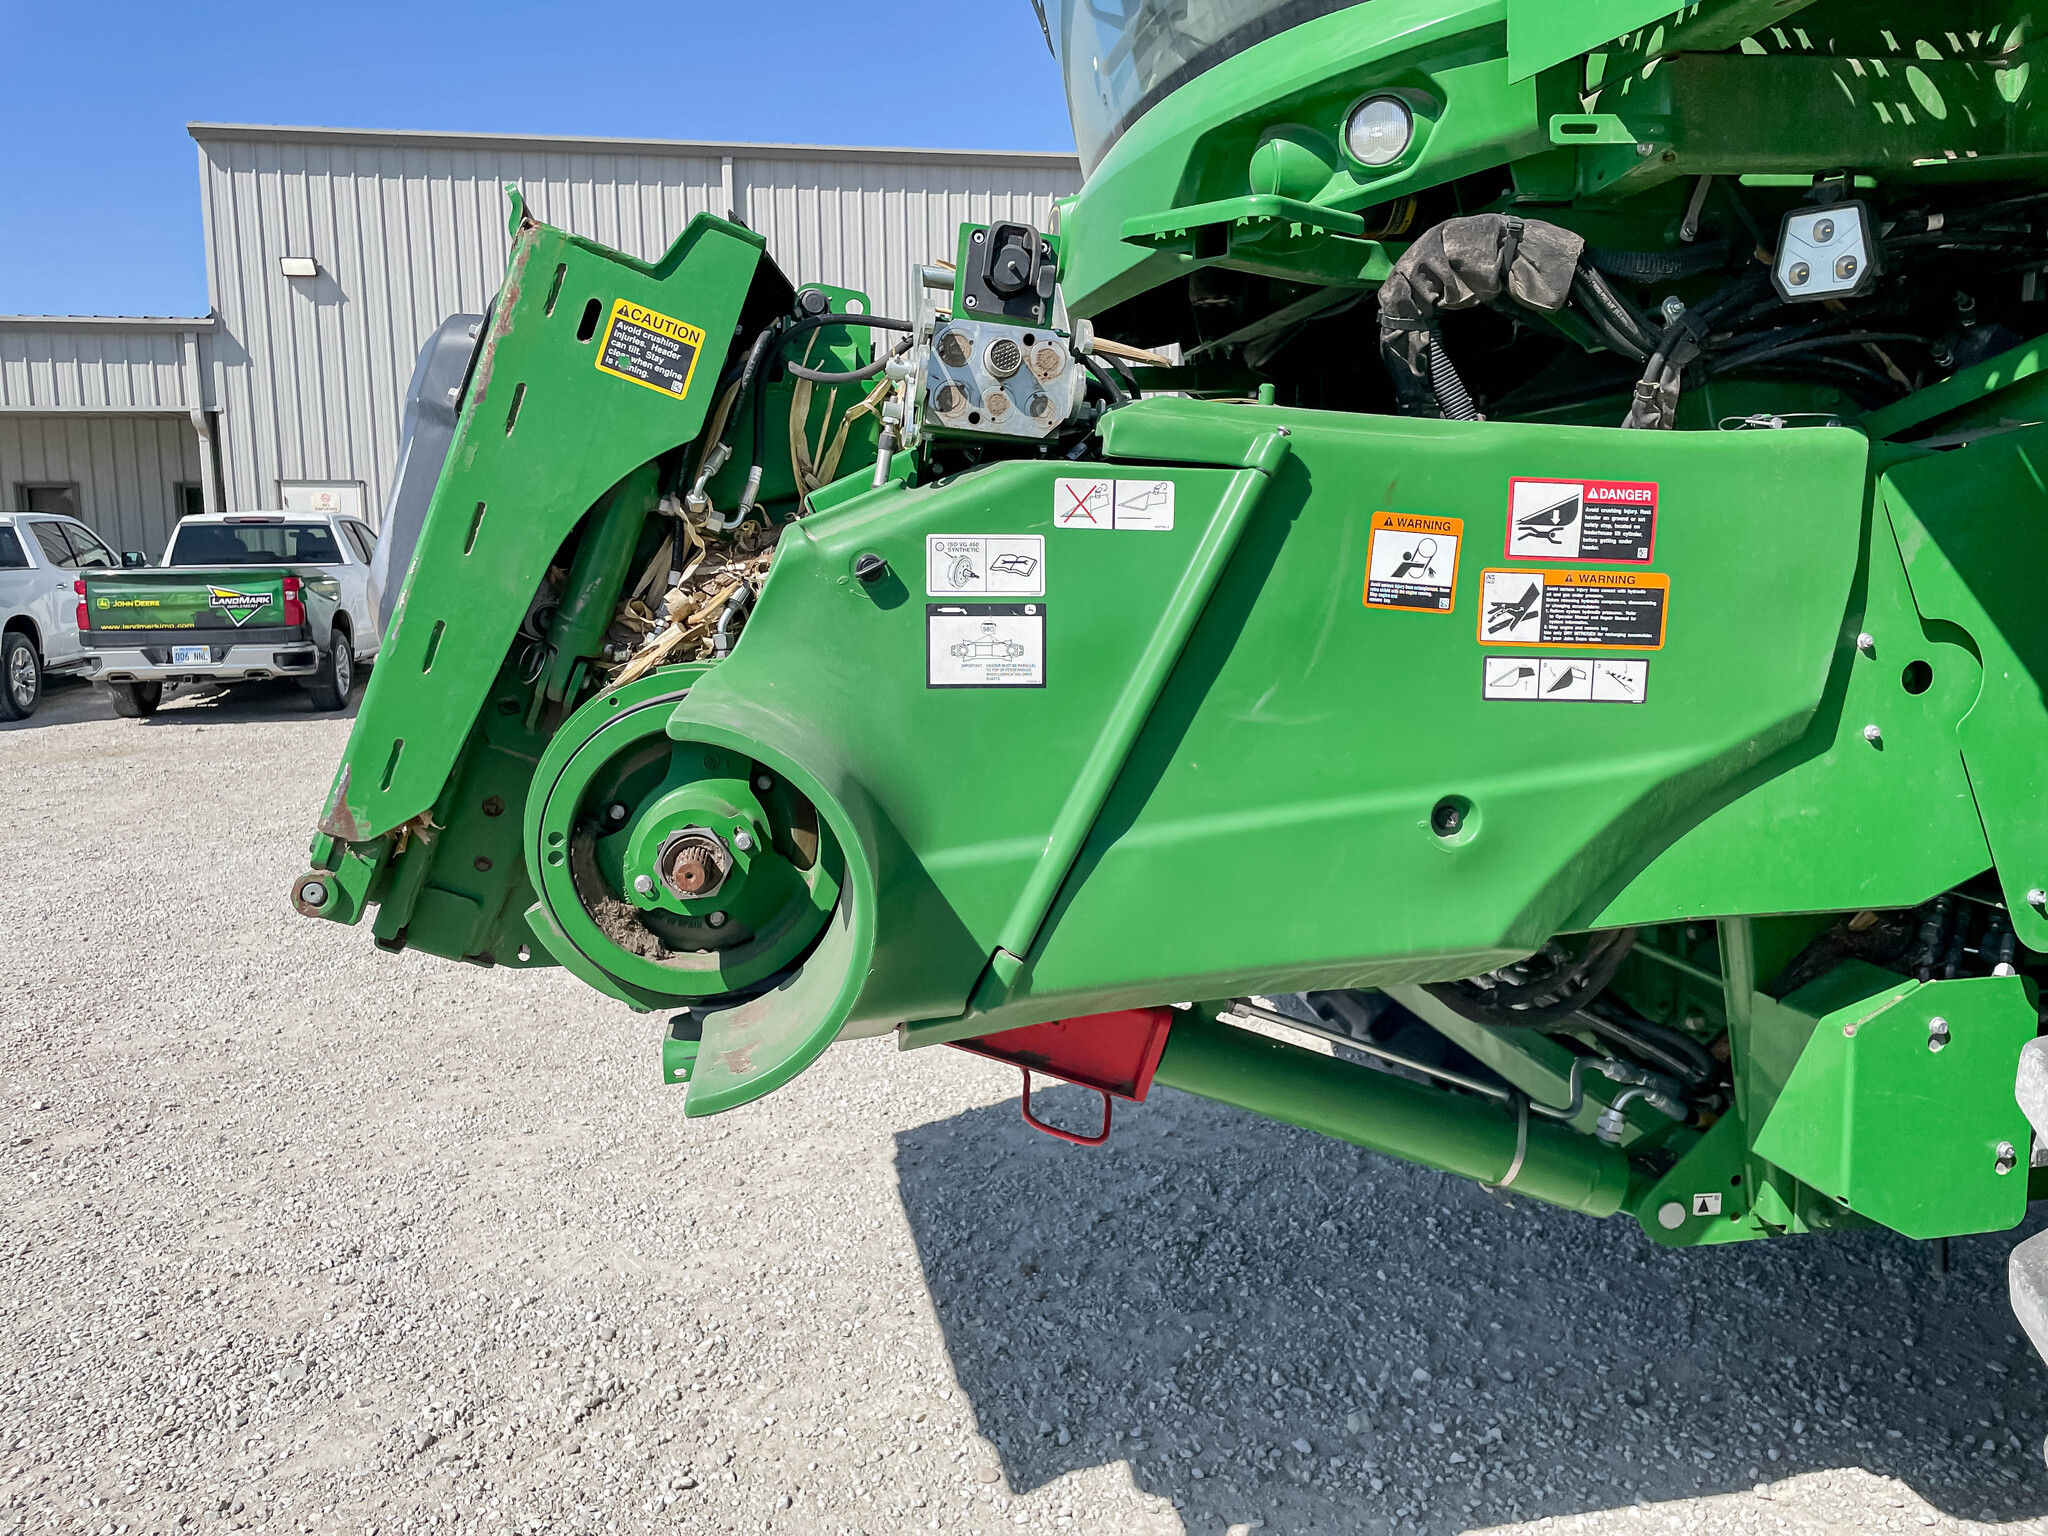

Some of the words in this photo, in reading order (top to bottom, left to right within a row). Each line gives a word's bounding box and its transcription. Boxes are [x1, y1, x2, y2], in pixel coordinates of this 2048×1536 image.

[631, 309, 700, 343] CAUTION
[616, 322, 642, 336] Avoid
[643, 332, 679, 352] crushing
[611, 340, 626, 350] can
[628, 344, 641, 355] tilt.
[645, 351, 665, 365] Stay
[651, 343, 681, 360] Header
[615, 359, 649, 379] rning.
[631, 356, 653, 369] when
[654, 365, 682, 380] engine
[1600, 488, 1651, 501] DANGER
[1397, 518, 1451, 531] WARNING
[1579, 574, 1635, 584] WARNING
[176, 652, 189, 661] 006
[194, 652, 208, 661] NNL
